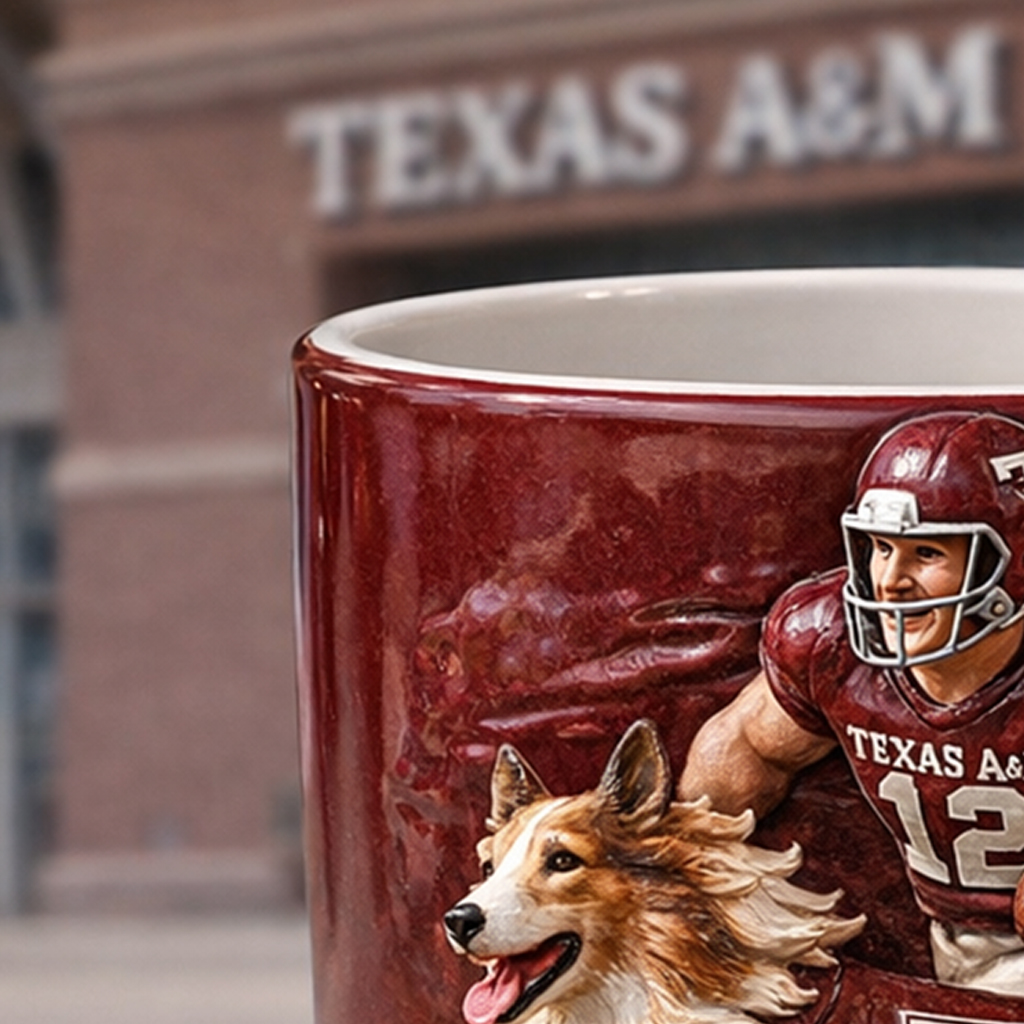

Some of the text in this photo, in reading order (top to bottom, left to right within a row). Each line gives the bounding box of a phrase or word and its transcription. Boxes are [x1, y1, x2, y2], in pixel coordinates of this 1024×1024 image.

[288, 22, 1005, 217] TEXAS A&M
[847, 725, 965, 779] TEXAS
